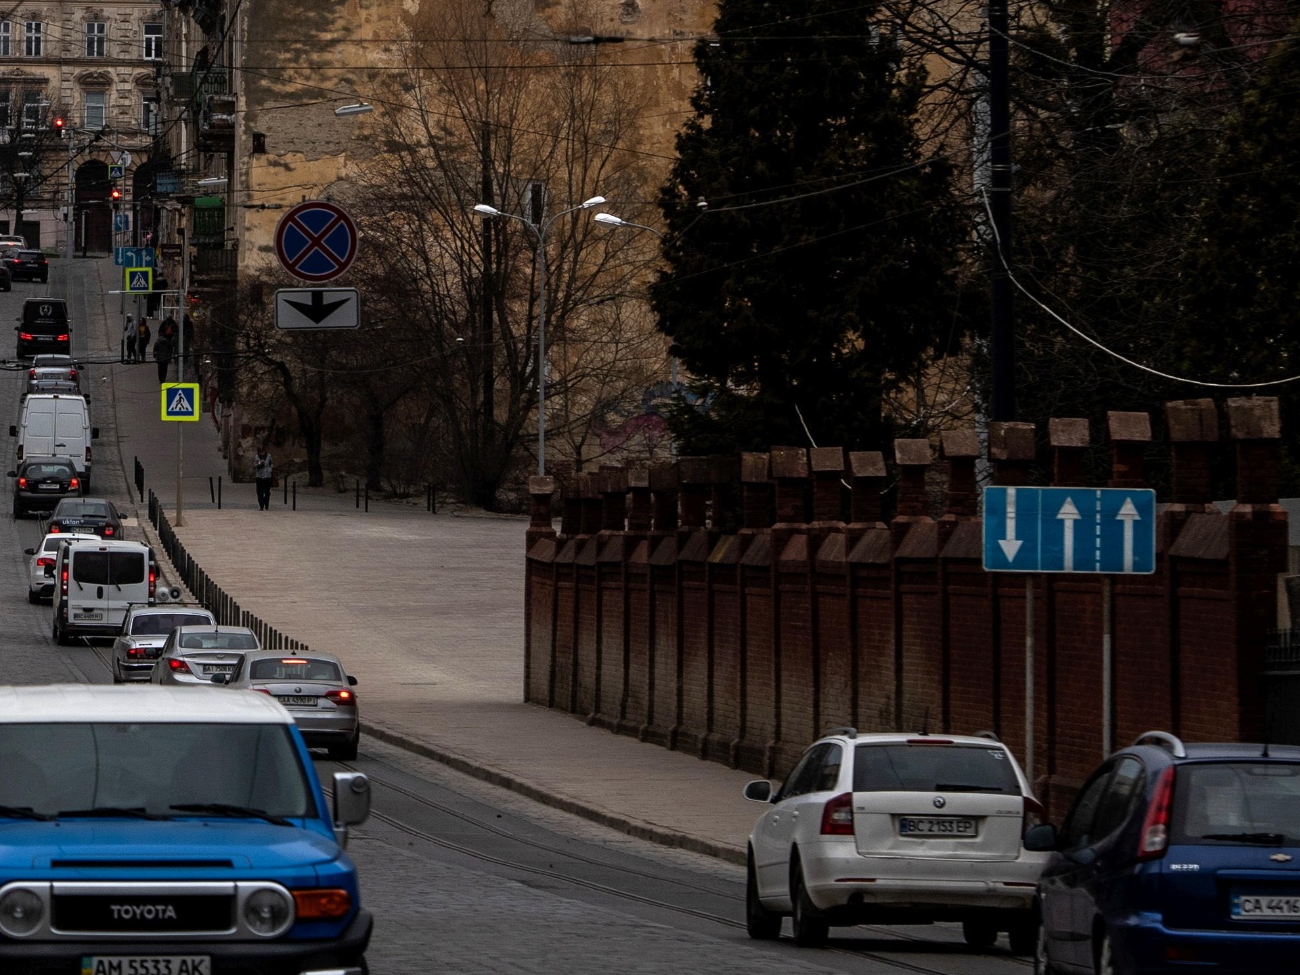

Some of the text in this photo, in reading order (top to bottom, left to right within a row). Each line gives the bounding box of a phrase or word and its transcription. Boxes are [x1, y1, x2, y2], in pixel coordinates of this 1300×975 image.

[908, 820, 972, 832] BC 2153 EP
[109, 905, 177, 919] TOYOTA
[1243, 899, 1263, 914] CA
[95, 959, 204, 975] AM 5533 AK
